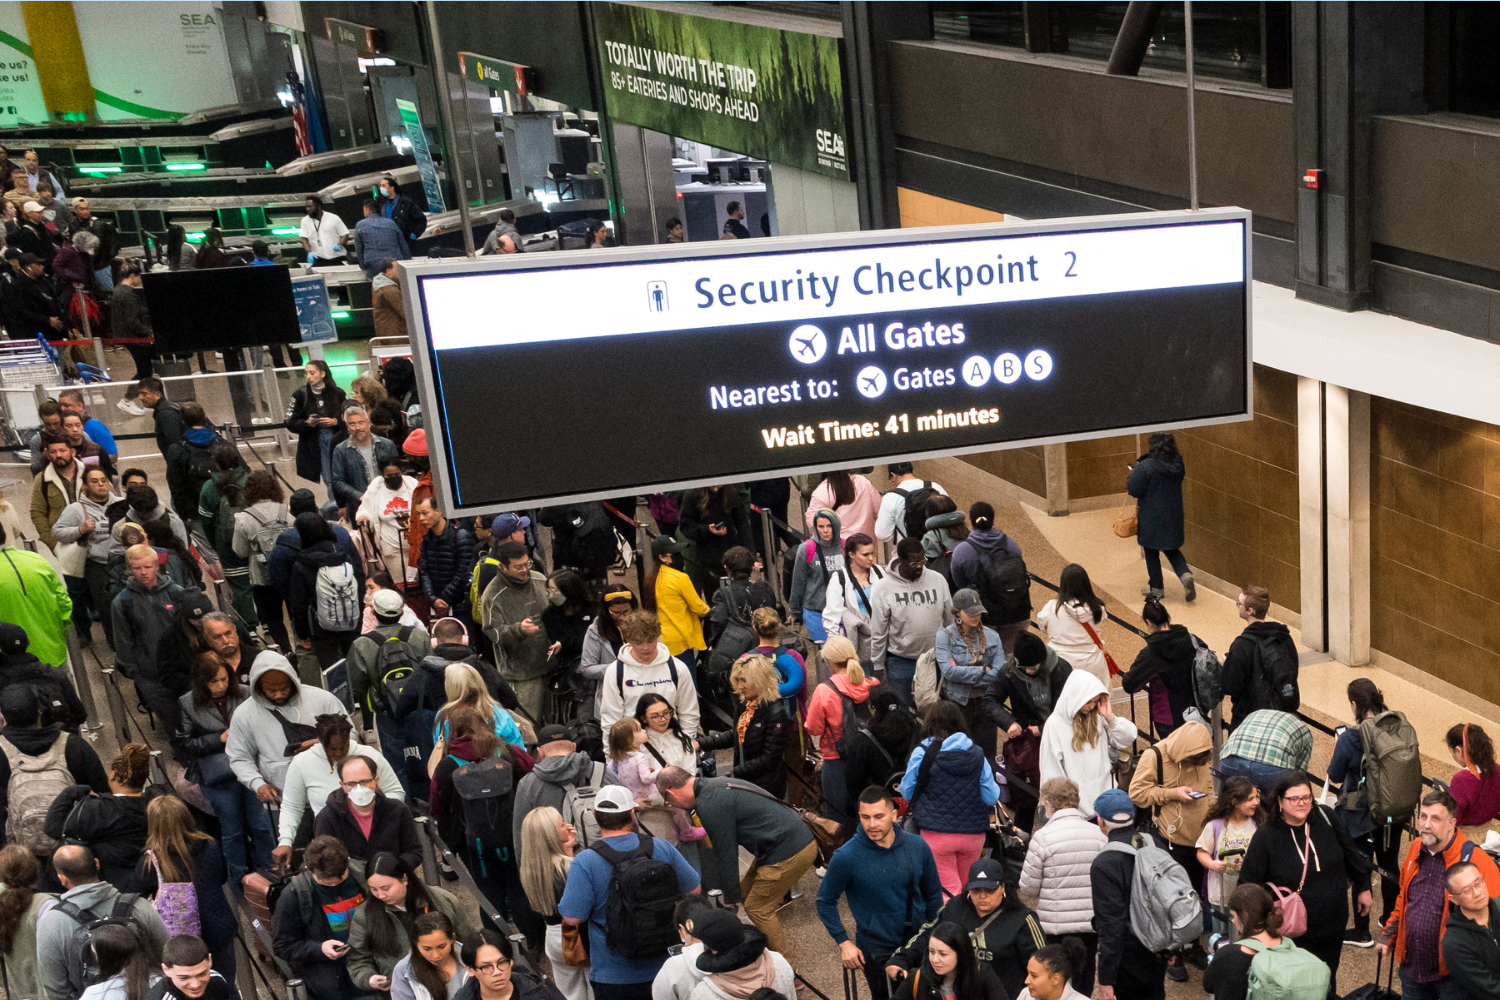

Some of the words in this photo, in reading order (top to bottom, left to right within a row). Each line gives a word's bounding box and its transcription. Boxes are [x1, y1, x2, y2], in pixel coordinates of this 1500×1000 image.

[180, 13, 216, 25] SEA
[605, 40, 651, 71] TOTALLY
[653, 50, 698, 82] WORTH
[698, 59, 726, 88] THE
[727, 64, 757, 94] TRIP
[611, 71, 626, 90] 85+
[627, 74, 668, 101] EATERIES
[669, 86, 688, 106] AND
[690, 91, 722, 114] SHOPS
[724, 98, 759, 123] AHEAD
[695, 268, 839, 308] Security
[854, 254, 1040, 297] Checkpoint
[1065, 251, 1078, 278] 2
[838, 323, 875, 355] All
[884, 321, 966, 350] Gates
[710, 382, 801, 410] Nearest
[807, 378, 839, 400] to:
[893, 367, 956, 391] Gates
[970, 363, 984, 381] A
[1003, 360, 1014, 378] B
[1034, 356, 1045, 375] S
[761, 424, 815, 449] Wait
[818, 421, 880, 442] Time:
[884, 413, 909, 435] 41
[916, 407, 1000, 432] minutes
[894, 589, 938, 606] HOU
[625, 679, 672, 688] Champion
